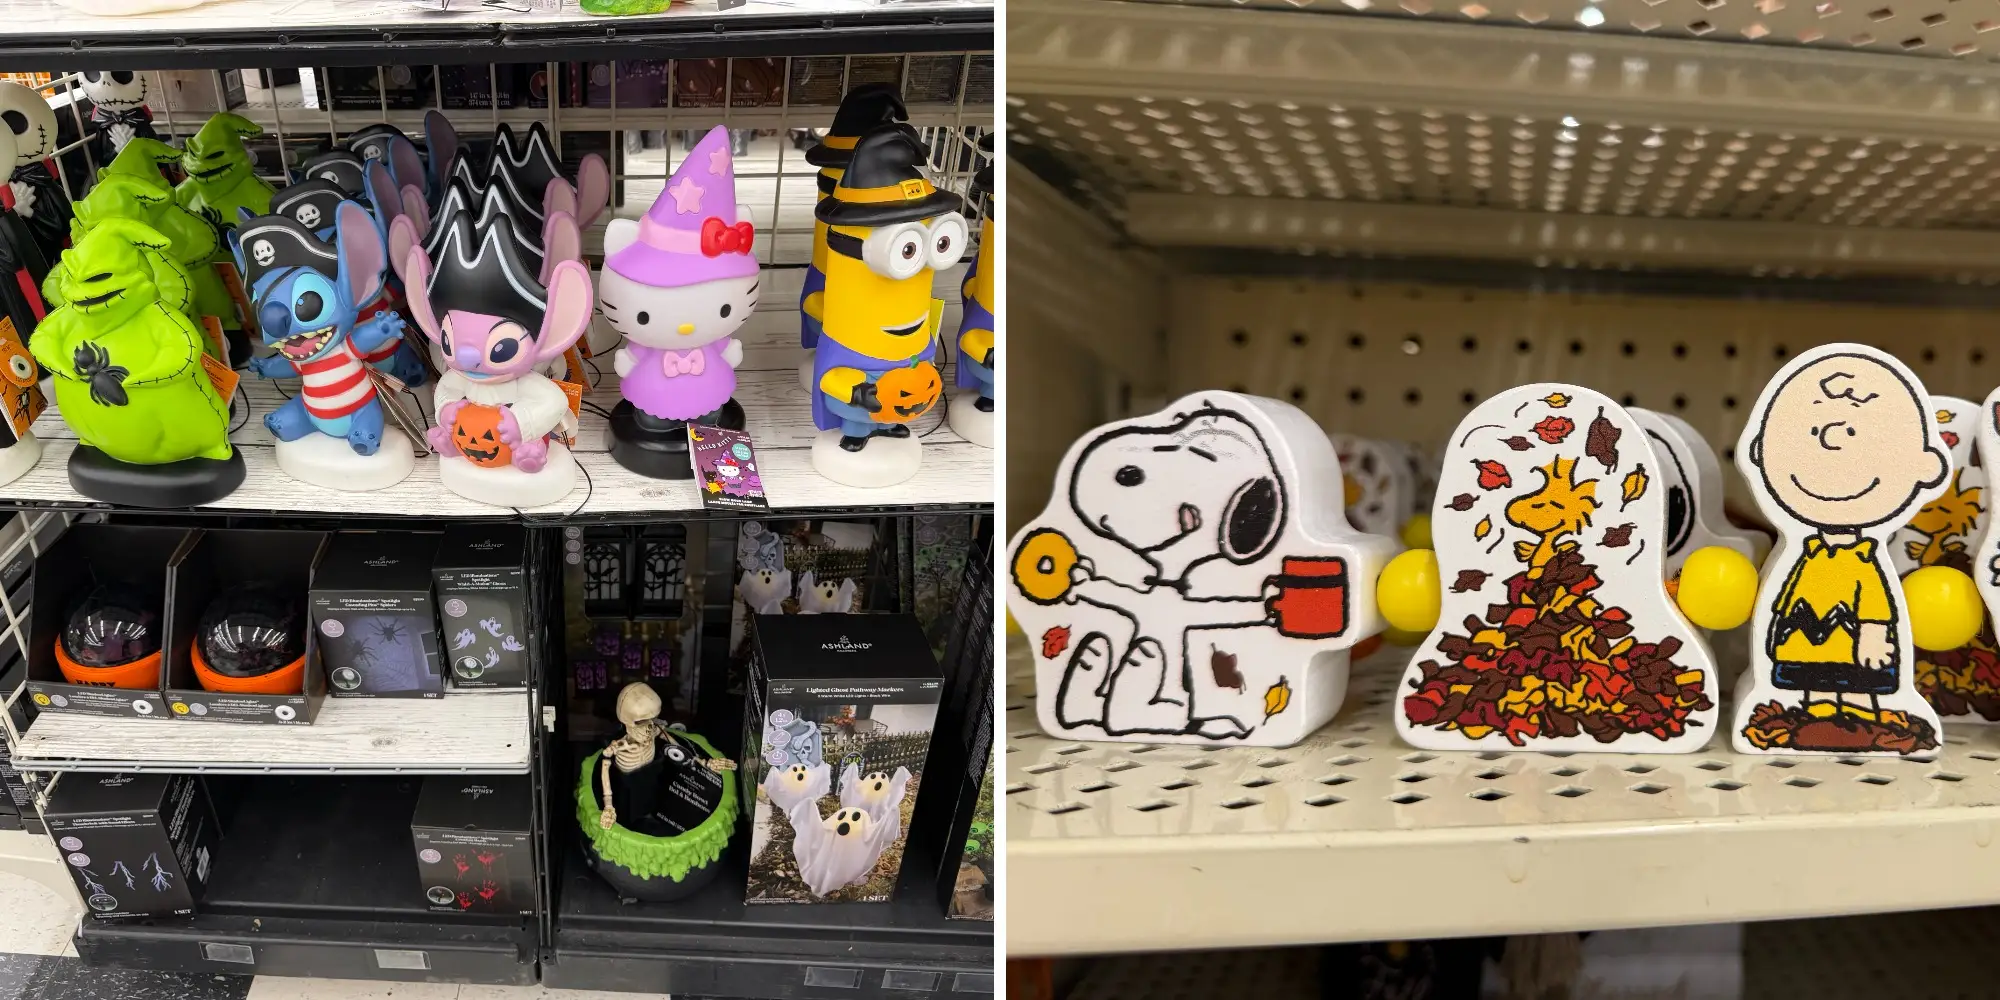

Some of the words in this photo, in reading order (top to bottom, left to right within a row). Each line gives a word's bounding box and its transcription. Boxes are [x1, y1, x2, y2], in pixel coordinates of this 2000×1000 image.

[696, 443, 717, 452] HELLO
[717, 435, 733, 448] KITTY
[821, 642, 873, 650] ASHLAND
[806, 687, 830, 695] Lighted
[672, 780, 693, 796] Candy
